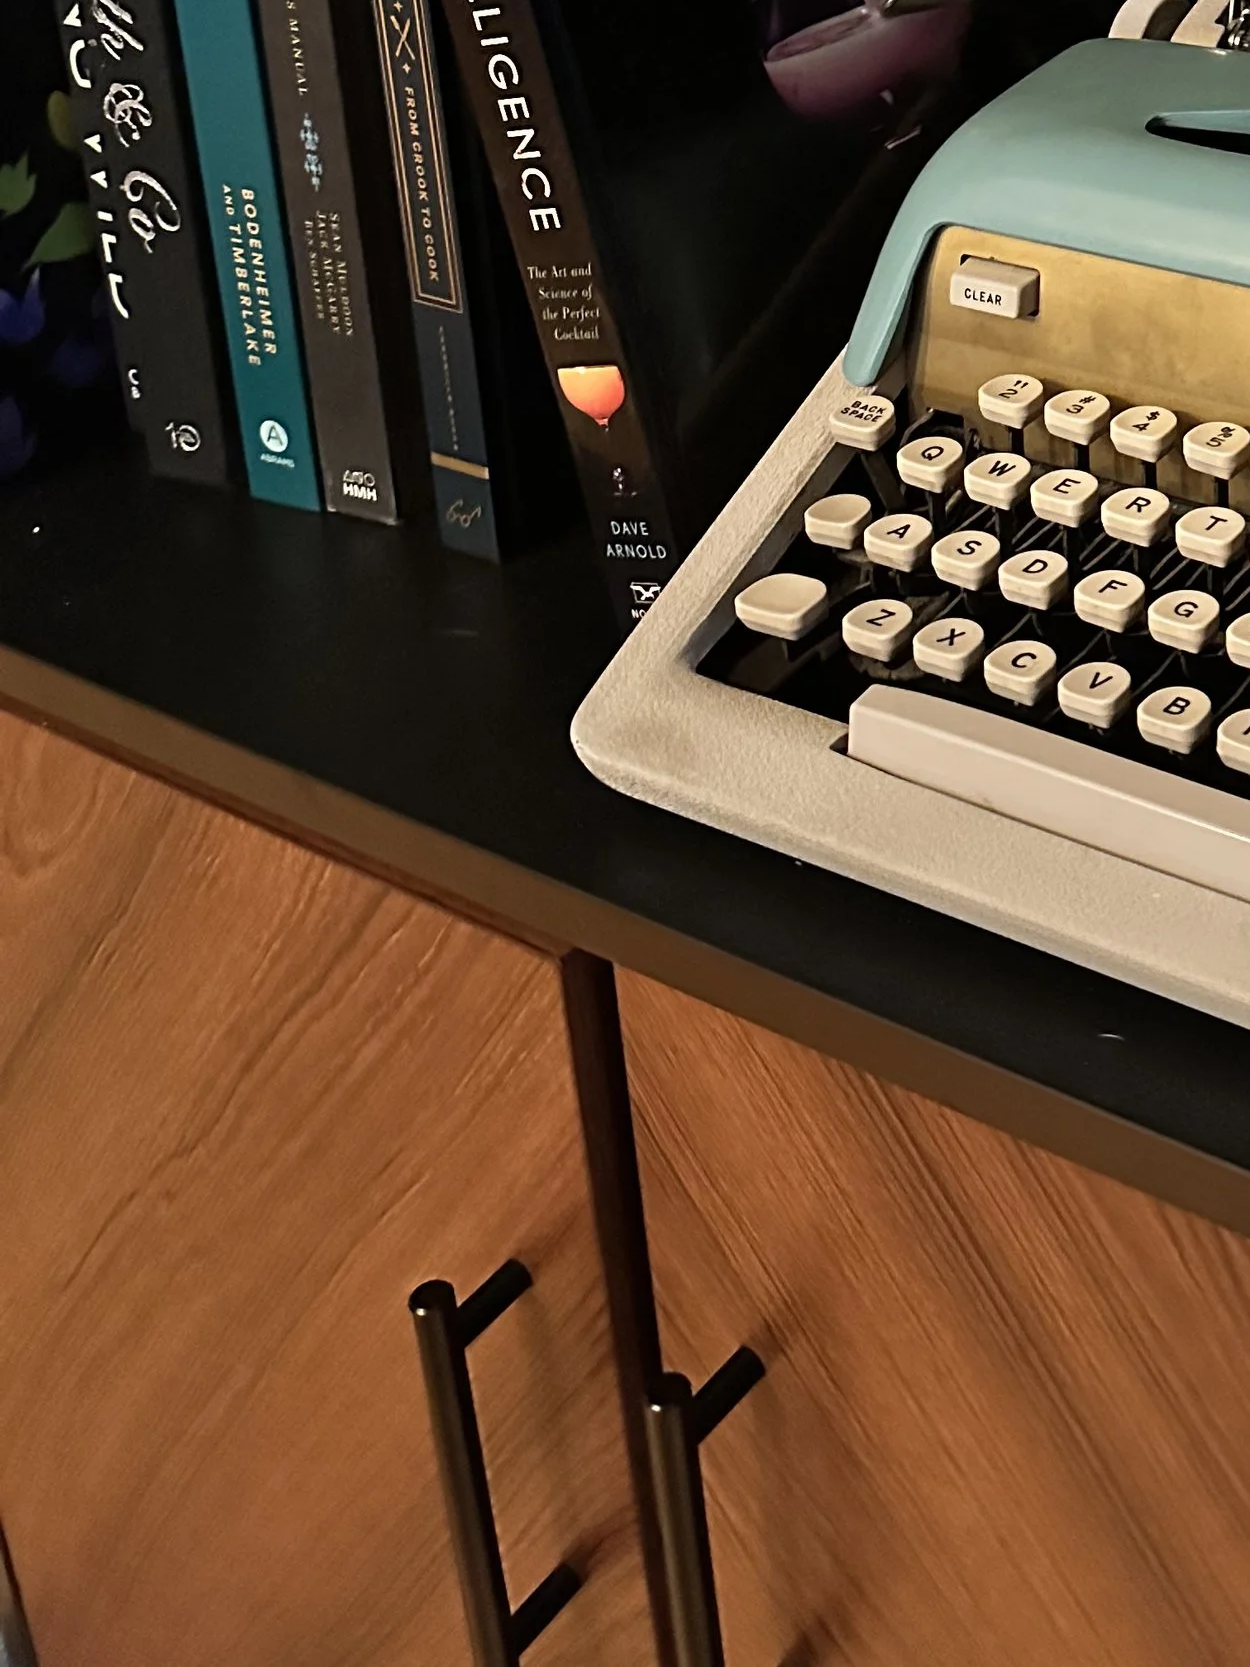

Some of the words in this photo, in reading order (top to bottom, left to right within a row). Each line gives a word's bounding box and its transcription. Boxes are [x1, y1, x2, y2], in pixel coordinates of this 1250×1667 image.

[288, 17, 309, 97] MANUAL
[402, 85, 421, 134] FROM
[411, 140, 431, 202] CROOK
[222, 183, 236, 217] AND
[119, 169, 182, 254] Co
[421, 205, 433, 230] TO
[424, 233, 440, 283] COOK
[241, 188, 278, 356] BODENHEIMER
[527, 265, 548, 281] The
[550, 263, 568, 280] Art
[570, 261, 593, 278] and
[228, 222, 262, 367] TIMBERLAKE
[538, 285, 579, 301] Science
[580, 282, 594, 301] of
[964, 287, 1003, 307] CLEAR
[542, 305, 560, 322] the
[562, 304, 601, 324] Perfect
[553, 324, 600, 341] Cocktail
[998, 389, 1018, 399] 2
[841, 406, 883, 424] SPACE
[851, 400, 886, 416] BACK
[1066, 404, 1081, 415] 3
[1132, 421, 1150, 432] 4
[1206, 435, 1224, 448] 5
[921, 446, 944, 461] Q
[988, 461, 1016, 476] W
[342, 483, 378, 503] HMH
[1053, 478, 1081, 494] E
[1125, 497, 1151, 513] R
[609, 520, 650, 537] DAVE
[887, 524, 910, 539] A
[1205, 516, 1228, 530] T
[605, 542, 668, 560] ARNOLD
[957, 541, 982, 555] S
[1022, 559, 1048, 573] D
[1098, 580, 1127, 593] F
[866, 609, 896, 626] Z
[1174, 602, 1198, 618] G
[936, 629, 965, 647] X
[1011, 653, 1037, 668] C
[1089, 672, 1113, 689] V
[1163, 697, 1190, 715] B
